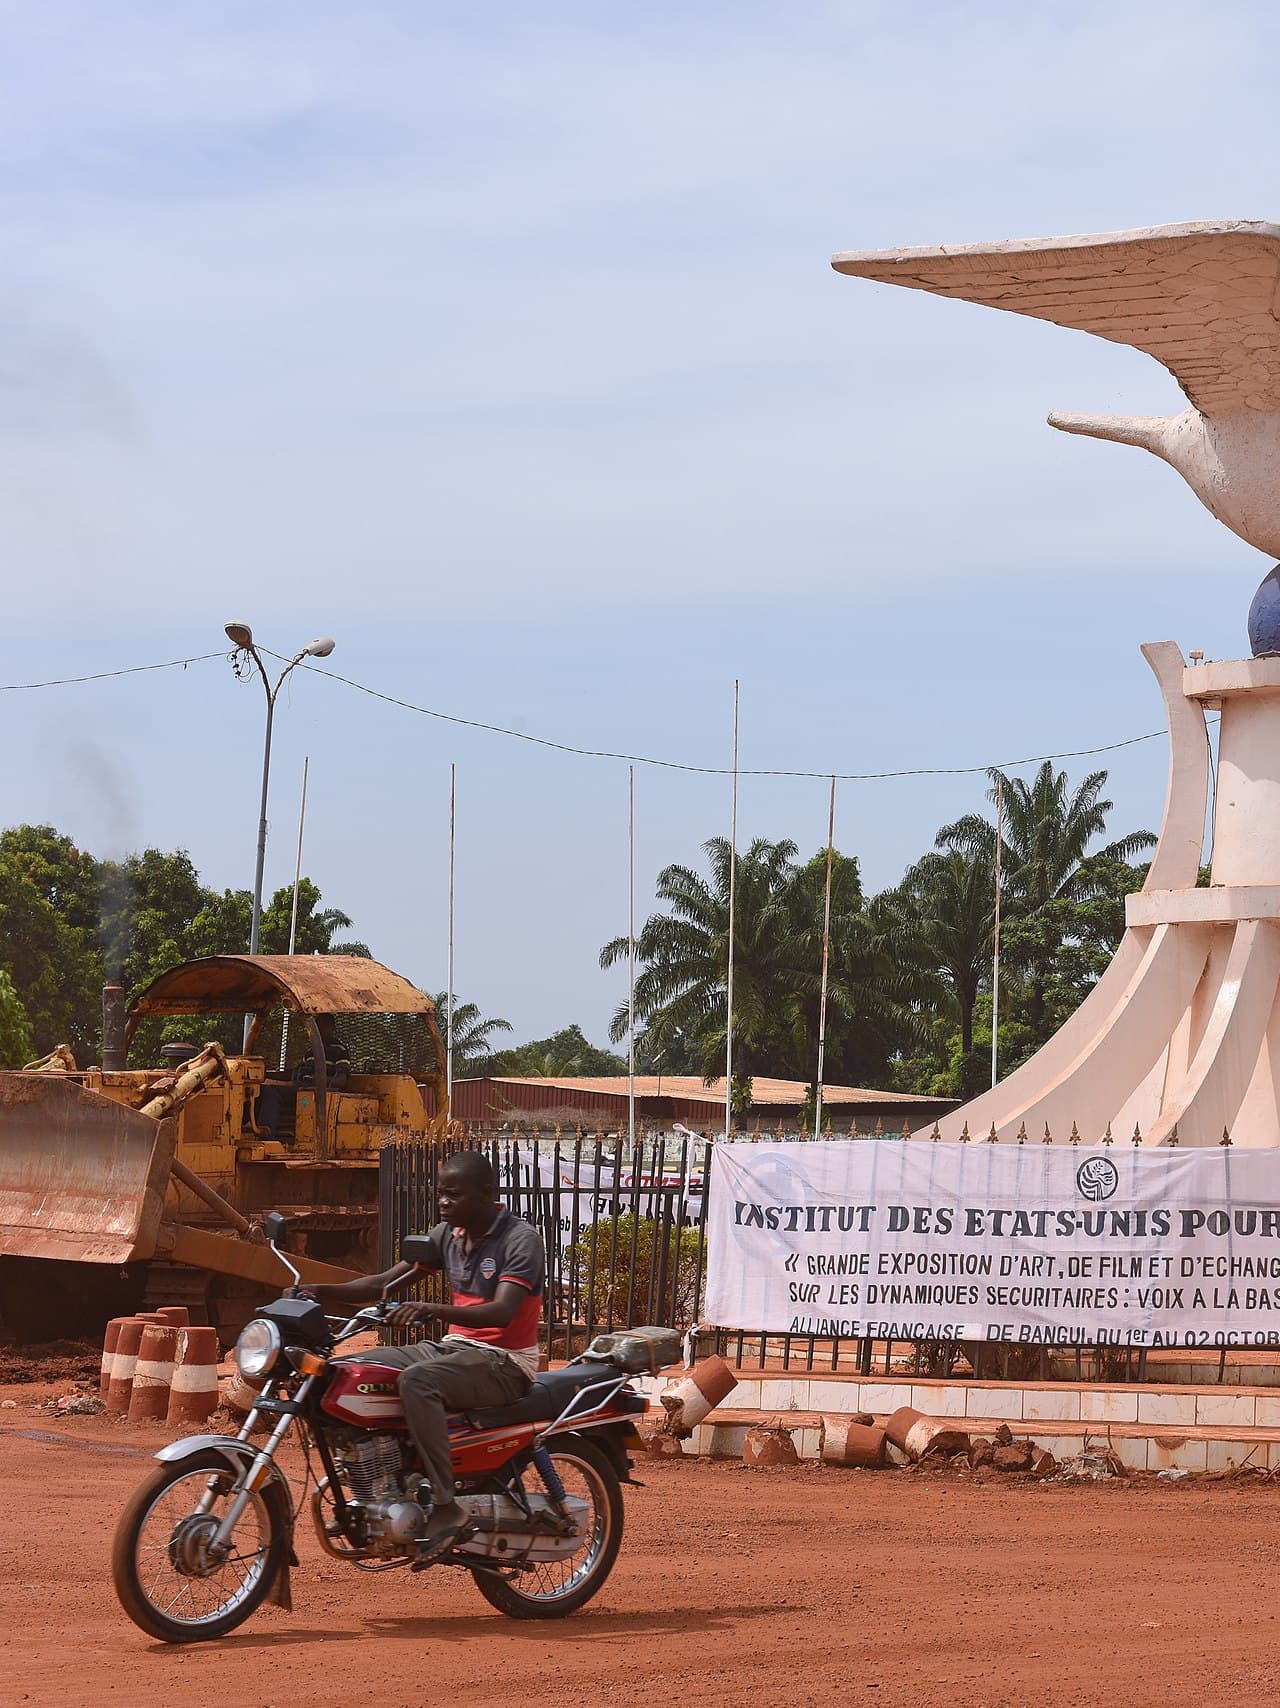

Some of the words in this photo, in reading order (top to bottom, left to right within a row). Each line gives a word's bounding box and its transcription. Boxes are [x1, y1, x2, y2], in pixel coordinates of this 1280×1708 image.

[734, 1199, 877, 1233] INSTITUT
[886, 1205, 954, 1236] DES
[963, 1207, 1172, 1238] ETATS-UNIS
[807, 1252, 871, 1276] GRANDE
[877, 1252, 993, 1277] EXPOSITION
[1068, 1256, 1093, 1278] DE
[1099, 1256, 1142, 1278] FILM
[1148, 1256, 1174, 1278] ET
[788, 1281, 821, 1304] SUR
[827, 1283, 860, 1306] LES
[866, 1284, 979, 1308] DYNAMIQUES
[1137, 1288, 1185, 1310] VOIX
[1192, 1288, 1207, 1310] A
[1212, 1288, 1239, 1310] LA
[789, 1315, 861, 1337] ALLIANCE
[986, 1323, 1014, 1342] DE
[1096, 1328, 1121, 1345] DU
[1125, 1328, 1149, 1347] 1er
[1152, 1330, 1178, 1347] AU
